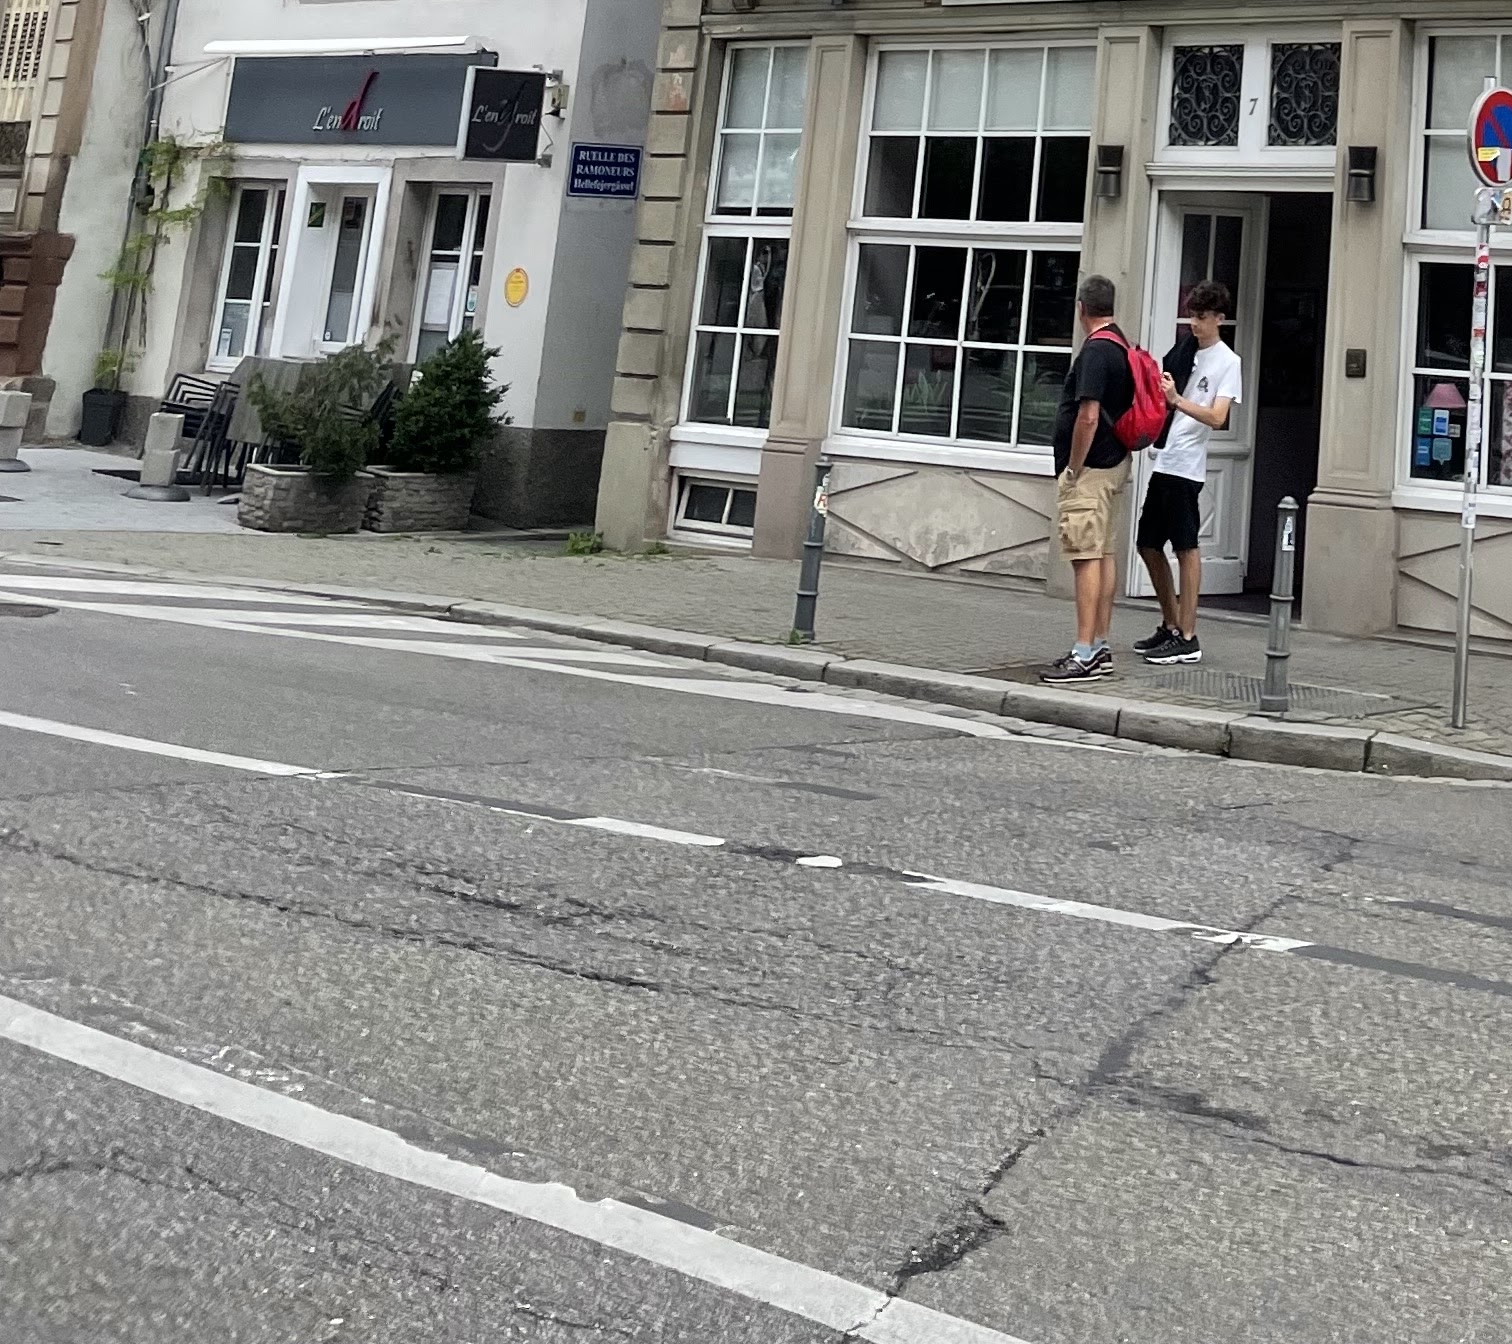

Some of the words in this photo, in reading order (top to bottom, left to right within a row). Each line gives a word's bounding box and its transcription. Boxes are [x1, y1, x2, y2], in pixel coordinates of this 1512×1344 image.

[312, 70, 384, 132] L'endroit
[1248, 97, 1259, 116] 7
[579, 150, 616, 162] RUELLE
[617, 153, 636, 163] DES
[576, 164, 635, 177] RAMONEURS
